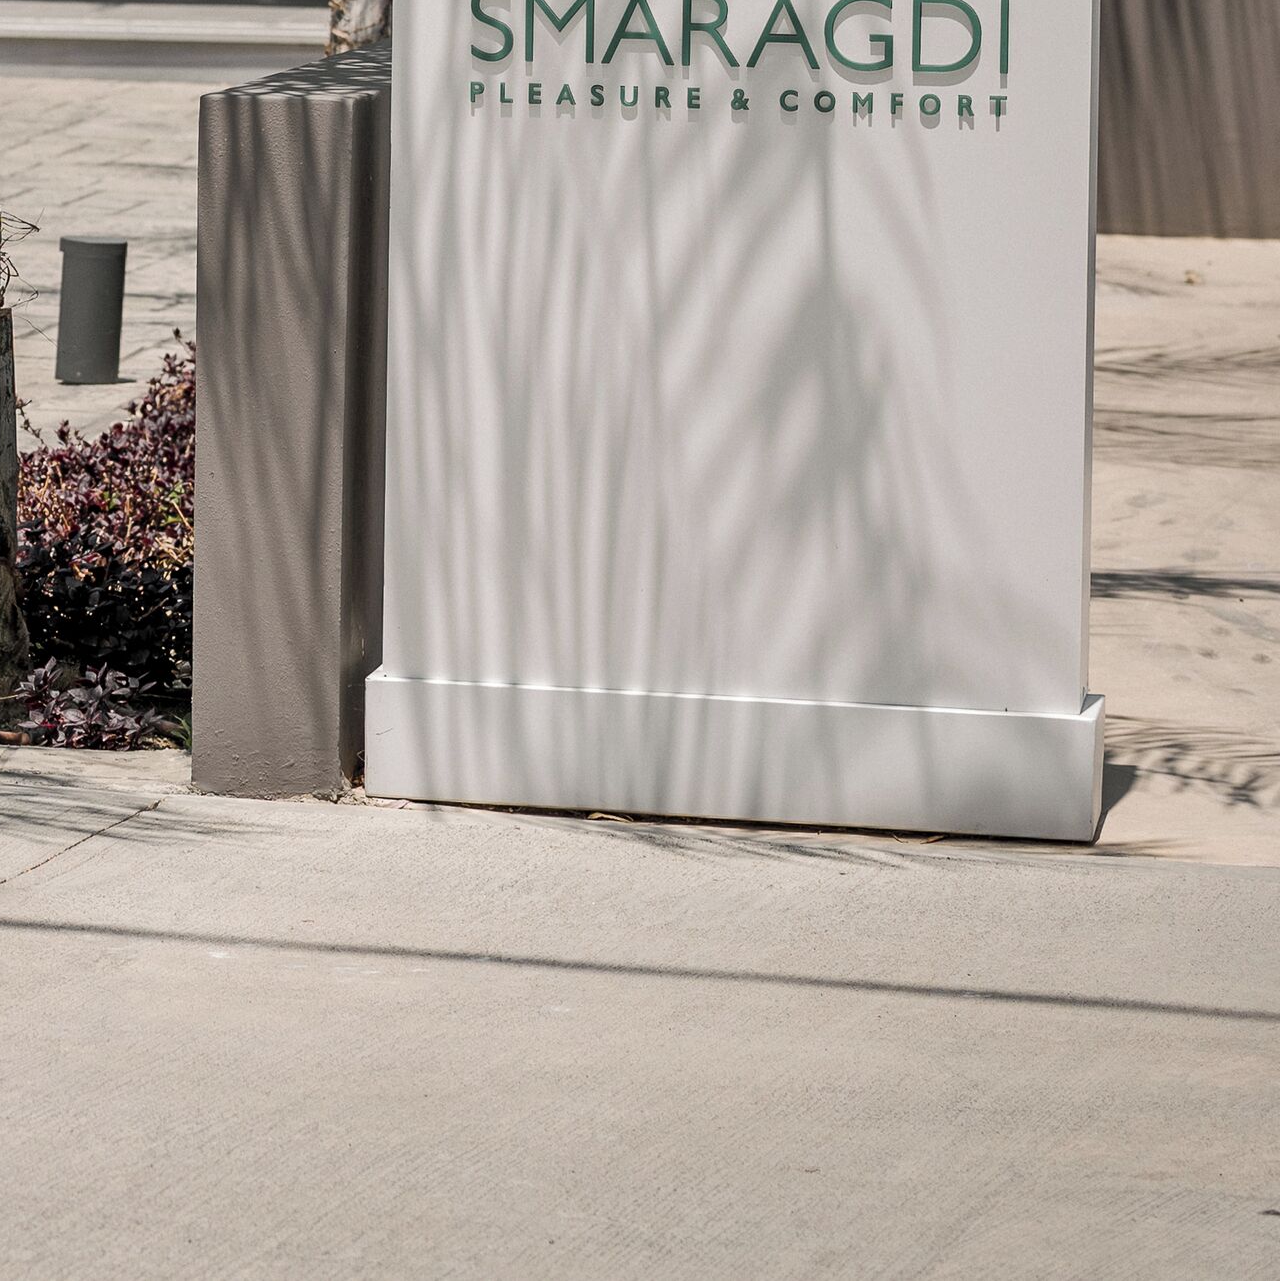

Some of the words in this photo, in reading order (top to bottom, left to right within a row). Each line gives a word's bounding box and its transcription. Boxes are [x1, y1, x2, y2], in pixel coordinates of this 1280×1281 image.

[469, 81, 701, 109] PLEASURE
[731, 89, 750, 111] &
[779, 89, 1009, 117] COMFORT
